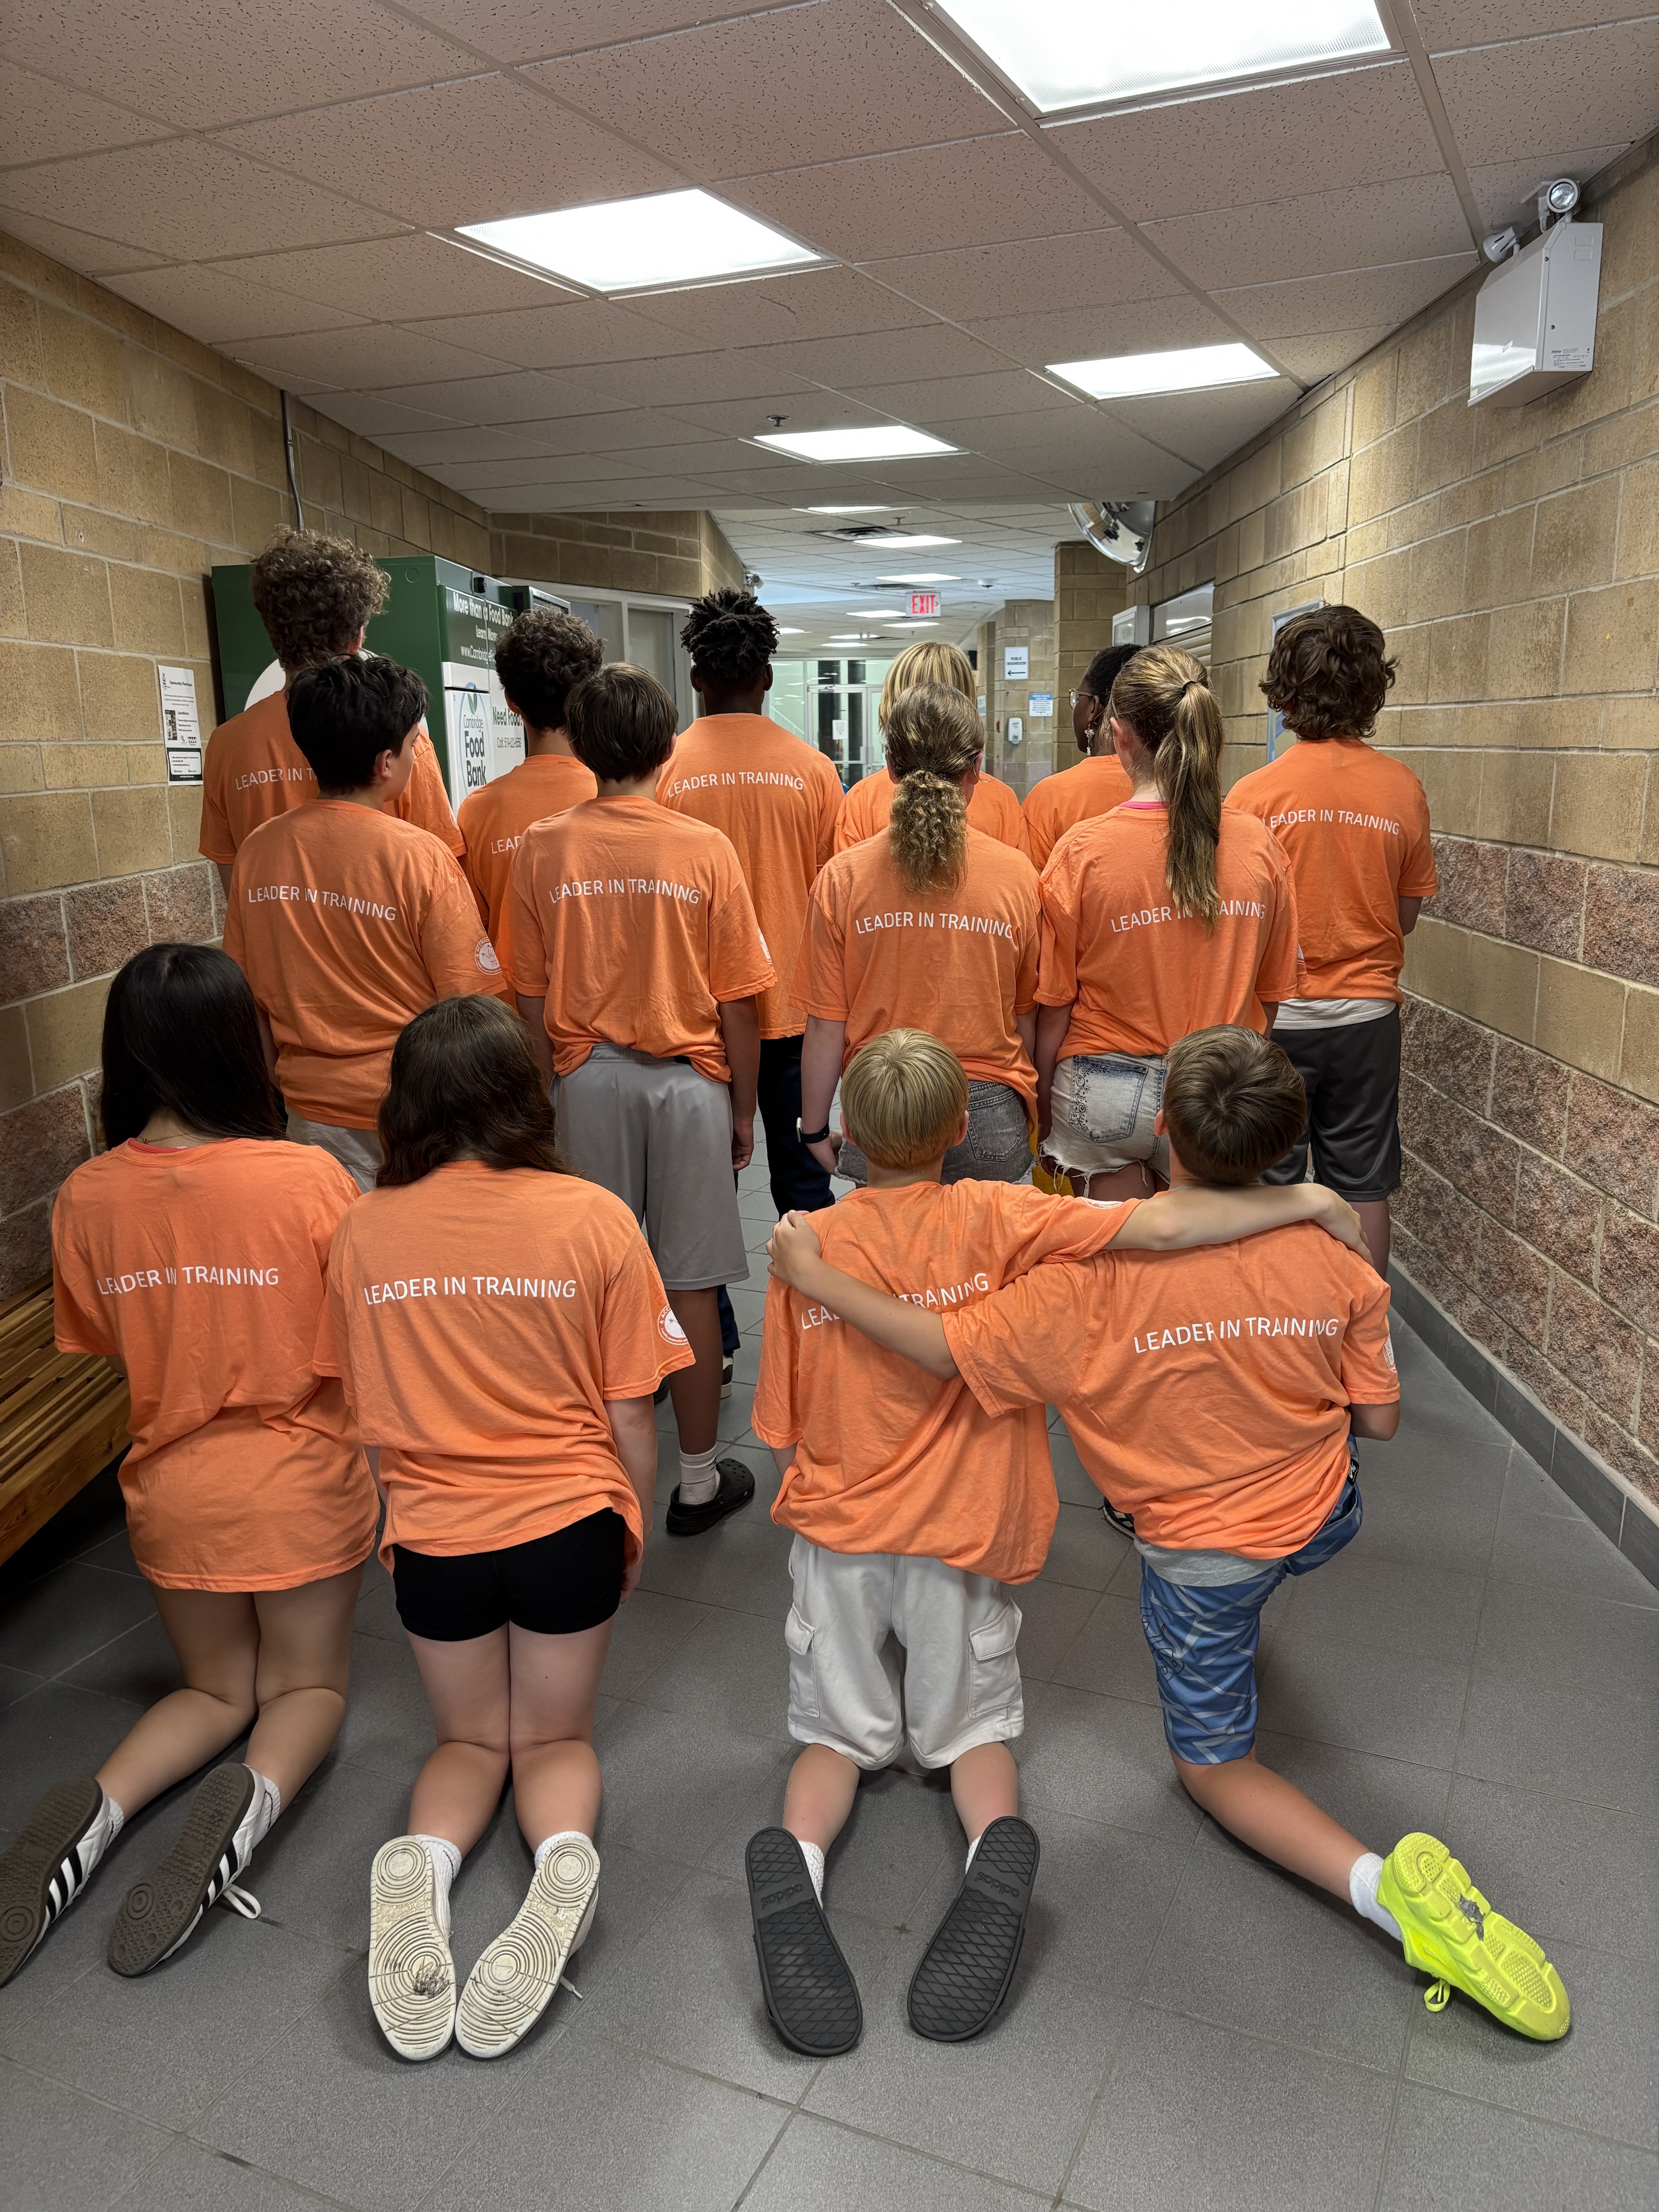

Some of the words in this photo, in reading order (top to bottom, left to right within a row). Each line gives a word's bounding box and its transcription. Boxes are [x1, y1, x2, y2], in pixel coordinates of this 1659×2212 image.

[453, 592, 469, 615] More
[469, 598, 482, 619] than
[488, 604, 502, 624] Food
[912, 594, 936, 614] EXIT
[475, 624, 487, 639] Learn
[463, 714, 483, 732] Cambridge
[492, 706, 508, 727] Need
[464, 731, 485, 758] Food
[235, 768, 284, 790] LEADER
[288, 768, 302, 781] IN
[466, 759, 487, 787] Bank
[667, 773, 718, 797] LEADER
[721, 772, 735, 785] IN
[739, 772, 804, 790] TRAINING
[1263, 809, 1316, 829] LEADER
[1320, 809, 1334, 822] IN
[1337, 810, 1399, 835] TRAINING
[248, 886, 300, 903] LEADER
[305, 888, 317, 903] IN
[322, 891, 397, 921] TRAINING
[549, 880, 604, 904] LEADER
[608, 879, 625, 893] IN
[628, 879, 701, 904] TRAINING
[856, 912, 913, 934] LEADER
[918, 912, 934, 927] IN
[1111, 907, 1172, 932] LEADER
[97, 1269, 162, 1295] LEADER
[165, 1267, 177, 1285] IN
[182, 1266, 279, 1286] TRAINING
[364, 1277, 437, 1305] LEADER
[444, 1276, 466, 1295] IN
[473, 1276, 577, 1298] TRAINING
[1134, 1322, 1218, 1354] LEADER
[1220, 1319, 1240, 1339] IN
[1245, 1316, 1339, 1338] TRAINING
[761, 1884, 803, 1909] adidas
[975, 1871, 1020, 1898] adidas
